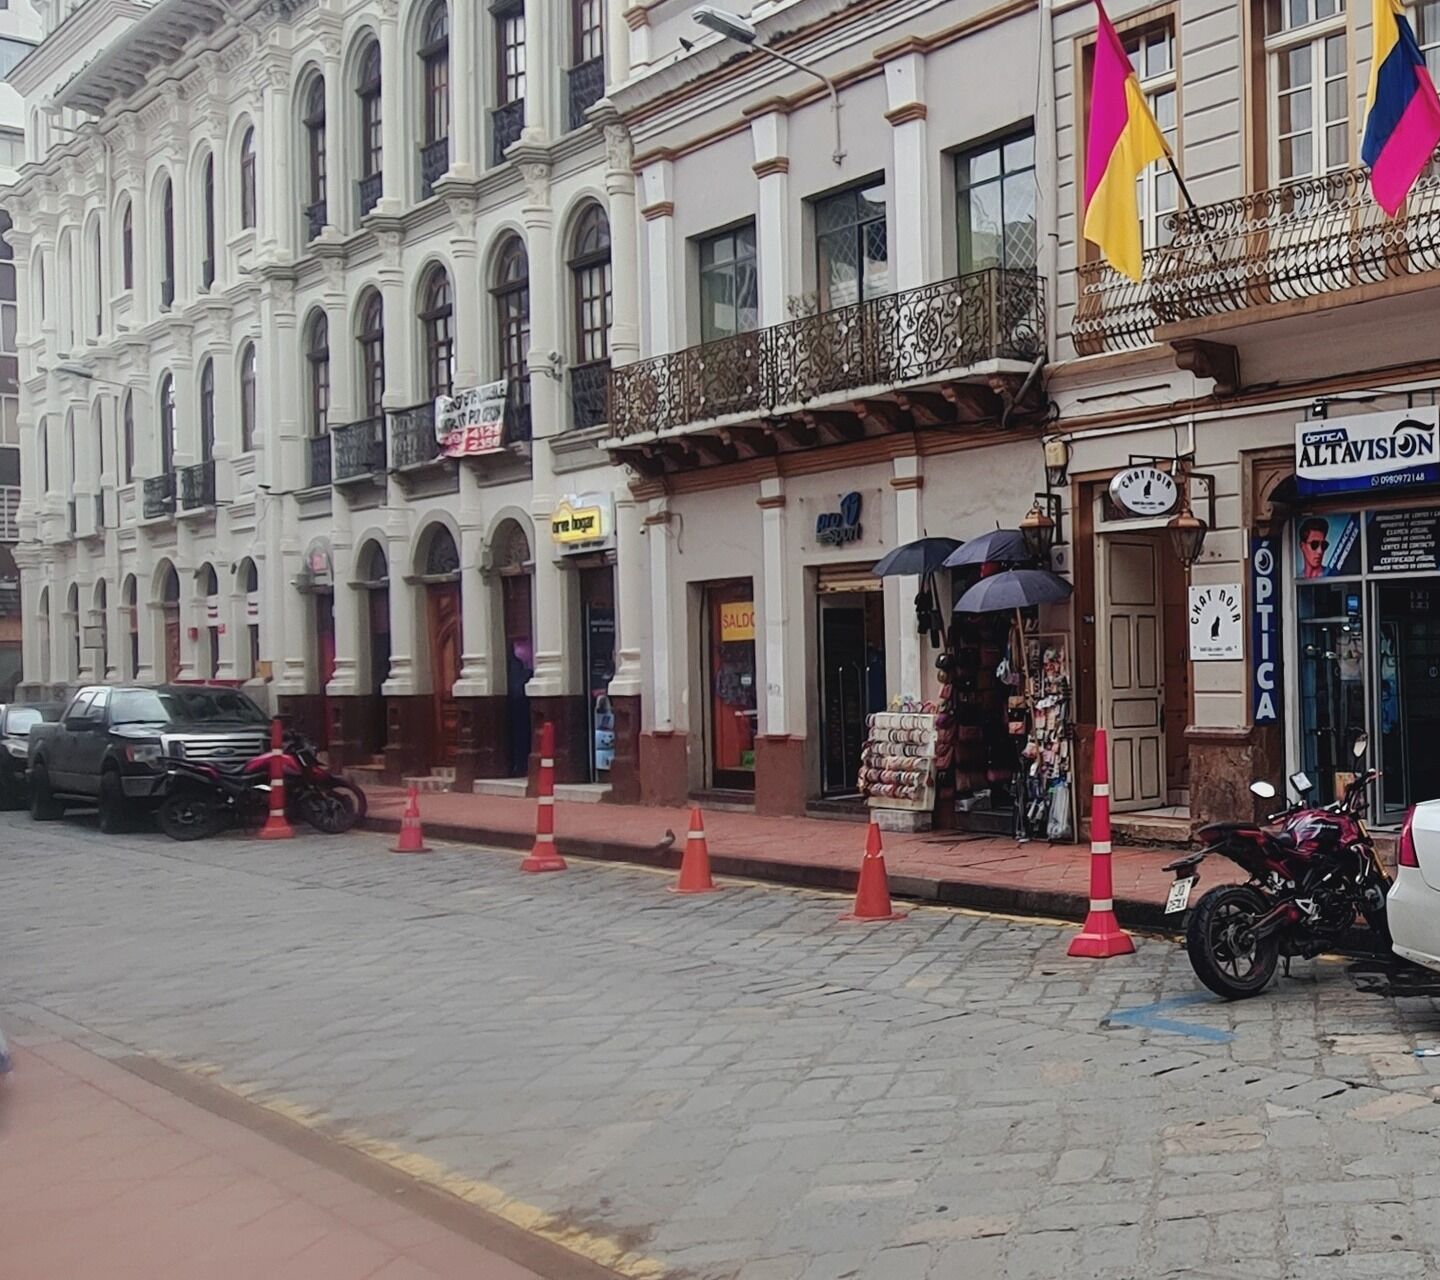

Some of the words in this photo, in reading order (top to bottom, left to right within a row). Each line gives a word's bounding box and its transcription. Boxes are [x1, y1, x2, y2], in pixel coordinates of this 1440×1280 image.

[1305, 432, 1345, 444] ÓPTICA
[1122, 470, 1144, 488] CHAT
[1150, 470, 1172, 489] NOIR
[571, 515, 594, 533] hogar
[1191, 589, 1212, 624] CHAT
[1219, 589, 1241, 623] NOIR
[1254, 540, 1276, 720] ÓPTICA
